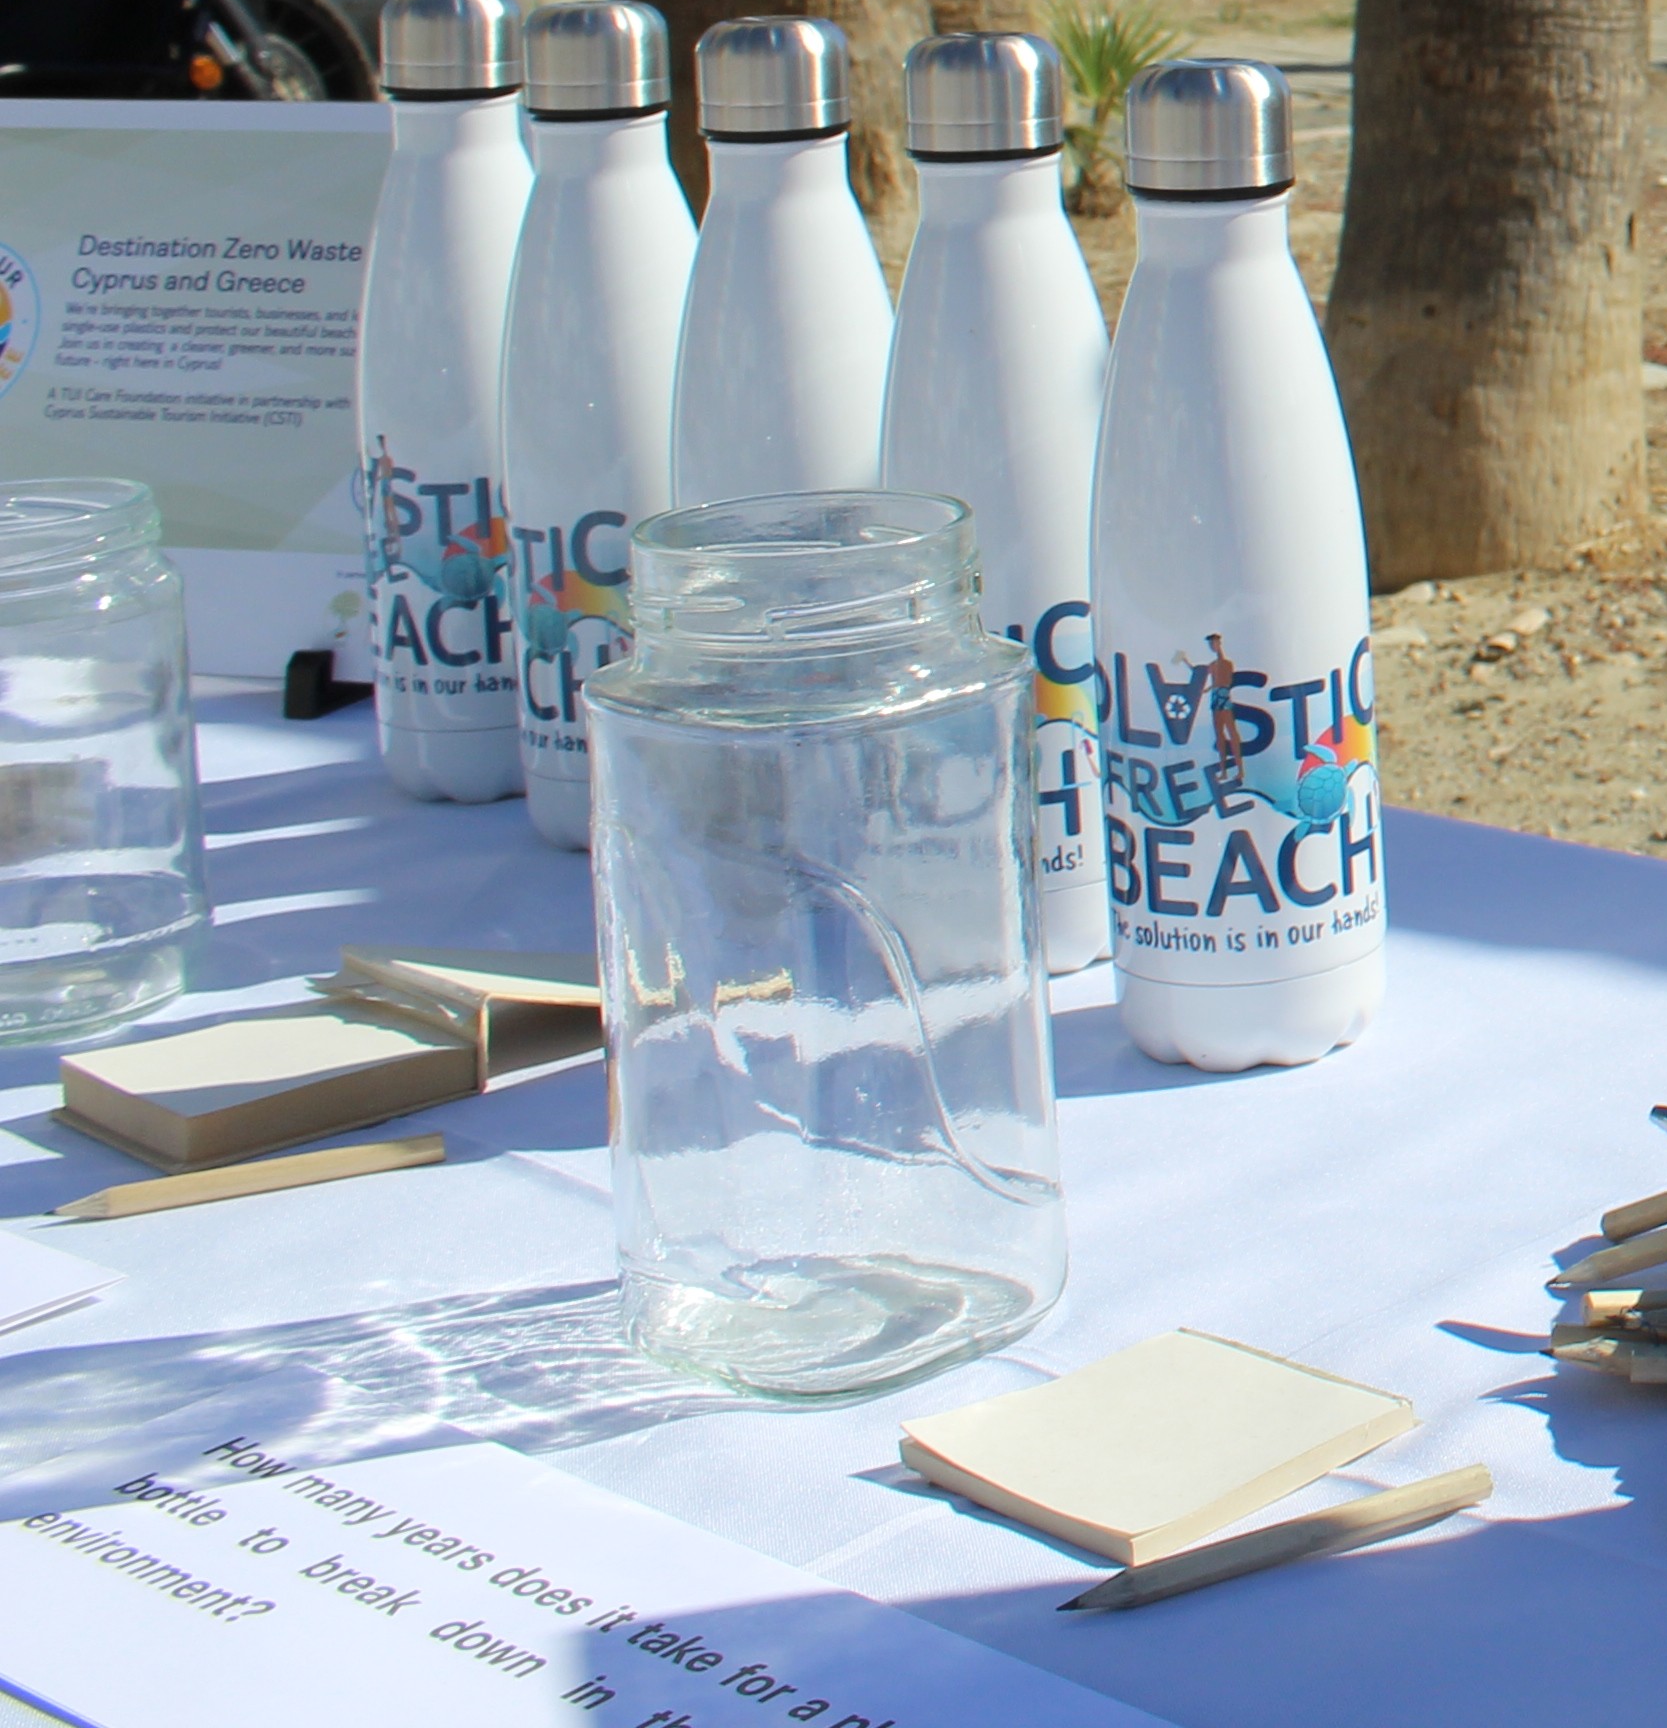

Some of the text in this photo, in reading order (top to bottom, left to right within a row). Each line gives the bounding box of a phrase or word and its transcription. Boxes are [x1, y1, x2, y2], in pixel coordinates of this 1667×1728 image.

[78, 234, 363, 263] Destination Zero Waste
[71, 267, 305, 295] Cyprus and Greece
[151, 304, 201, 321] together
[170, 323, 191, 335] and
[240, 326, 260, 337] our
[115, 389, 181, 404] Foundation
[413, 676, 467, 695] in our
[1106, 749, 1255, 820] FREE
[1106, 792, 1377, 917] BEACH
[1135, 921, 1217, 953] solution
[1227, 927, 1246, 952] is
[1257, 925, 1279, 949] in
[1288, 921, 1324, 945] our
[21, 1507, 278, 1626] environment?
[203, 1436, 830, 1721] How many years does it take for a
[113, 1471, 617, 1710] bottle to break down in
